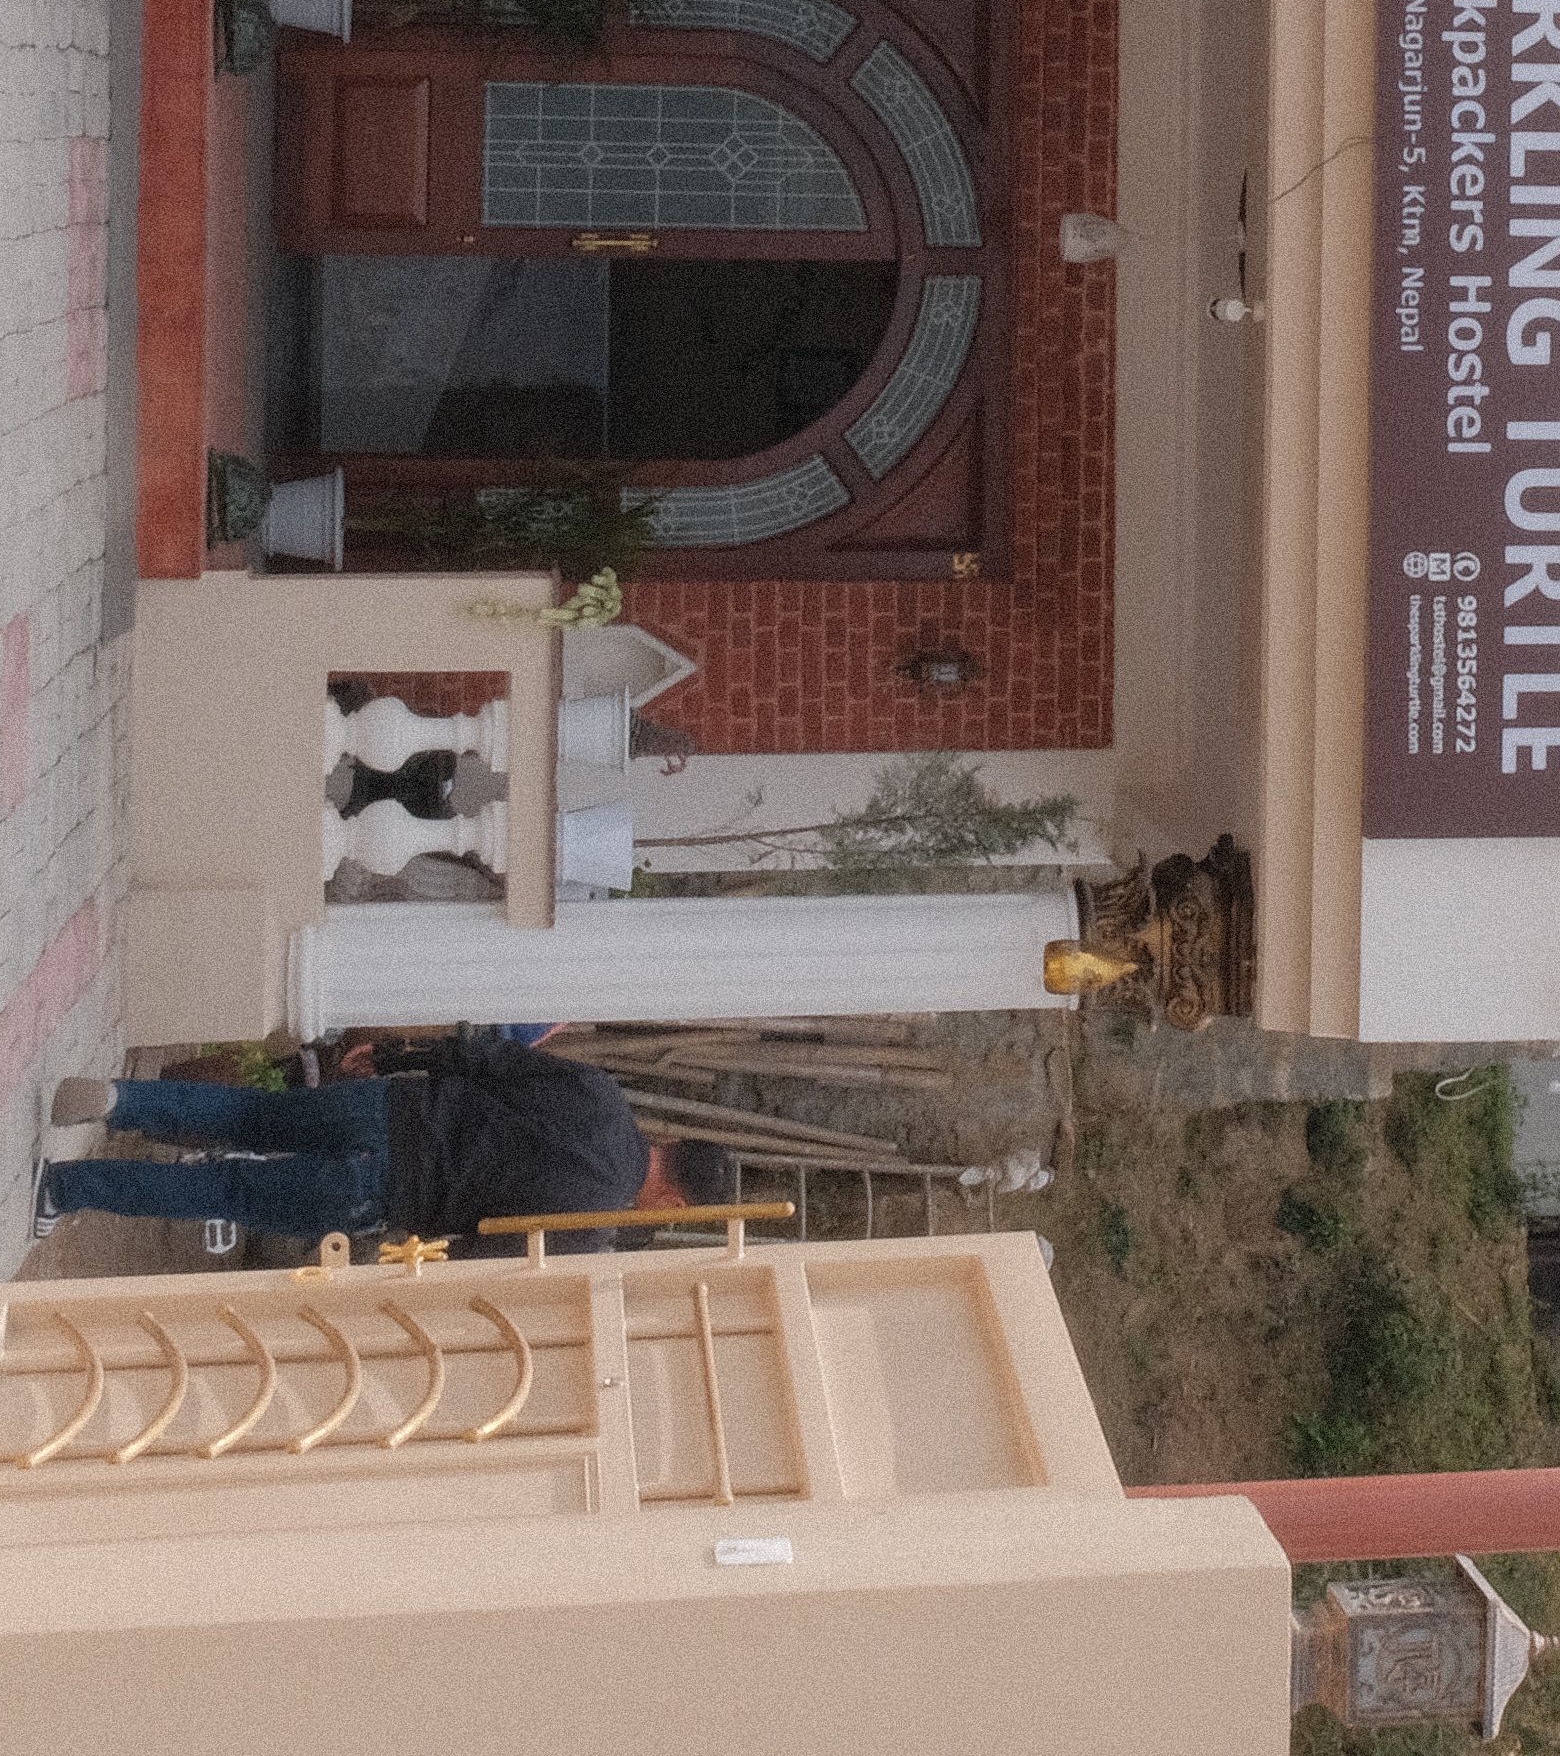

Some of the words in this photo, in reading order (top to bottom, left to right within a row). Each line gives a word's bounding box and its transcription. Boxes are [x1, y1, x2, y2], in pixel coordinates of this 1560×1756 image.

[1397, 185, 1425, 255] Ktm,
[1395, 267, 1425, 353] Nepal
[1447, 276, 1493, 453] Hostel
[1405, 594, 1423, 754] thesparklingturtle.com
[1429, 595, 1448, 754] tsthostel@gmail.com
[1455, 595, 1478, 754] 9813564272
